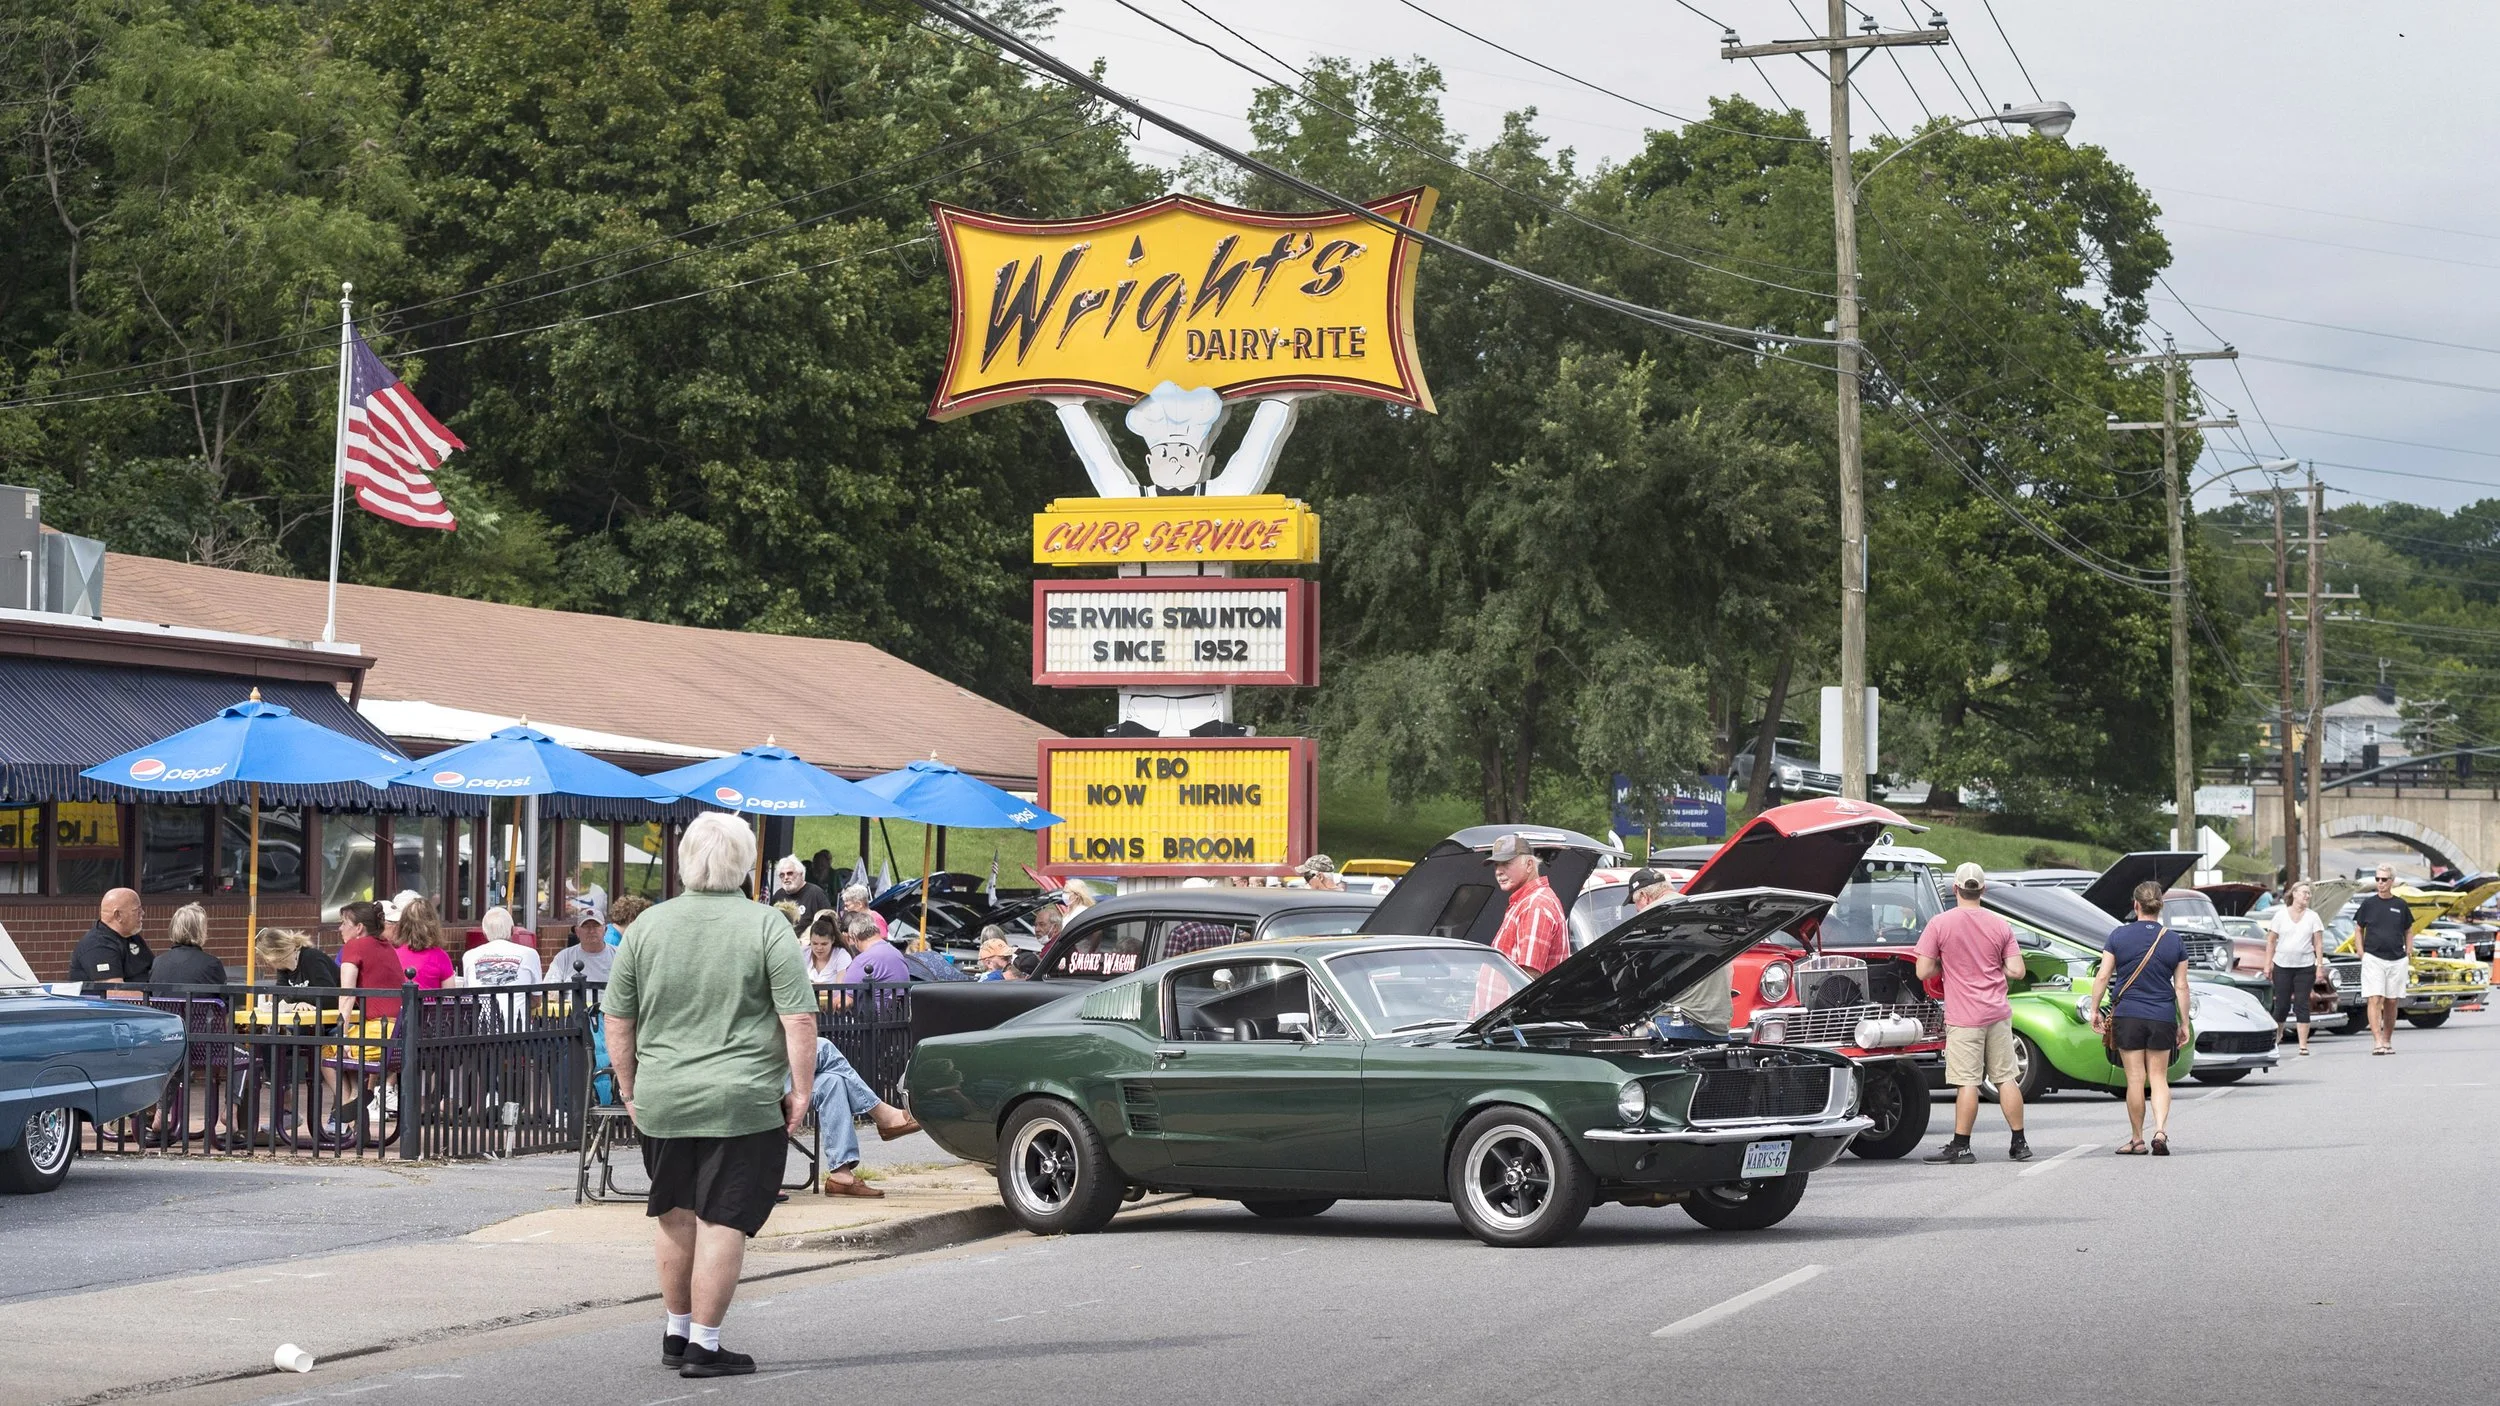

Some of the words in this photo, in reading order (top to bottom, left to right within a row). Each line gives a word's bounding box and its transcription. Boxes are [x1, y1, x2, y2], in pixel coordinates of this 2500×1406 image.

[980, 232, 1363, 374] Wright's
[1043, 521, 1140, 553] CURB
[1144, 518, 1288, 553] SERVICE
[1048, 607, 1153, 629] SERVING
[1163, 607, 1282, 629] STAUNTON
[1093, 640, 1166, 662] SINCE
[1194, 640, 1249, 662] 1952
[162, 763, 228, 783] pepsi
[466, 776, 532, 790] pepsi
[745, 797, 806, 811] pepsi
[1087, 784, 1146, 806] NOW
[1179, 784, 1262, 806] HIRING
[1681, 808, 1709, 816] SHERIFF
[1069, 837, 1145, 859] LIONS
[1163, 837, 1254, 859] BROOM
[1068, 951, 1101, 974] SMOKE
[1102, 952, 1137, 974] WAGON
[1745, 1151, 1788, 1170] MARKS-67
[1958, 1148, 1971, 1158] FILA
